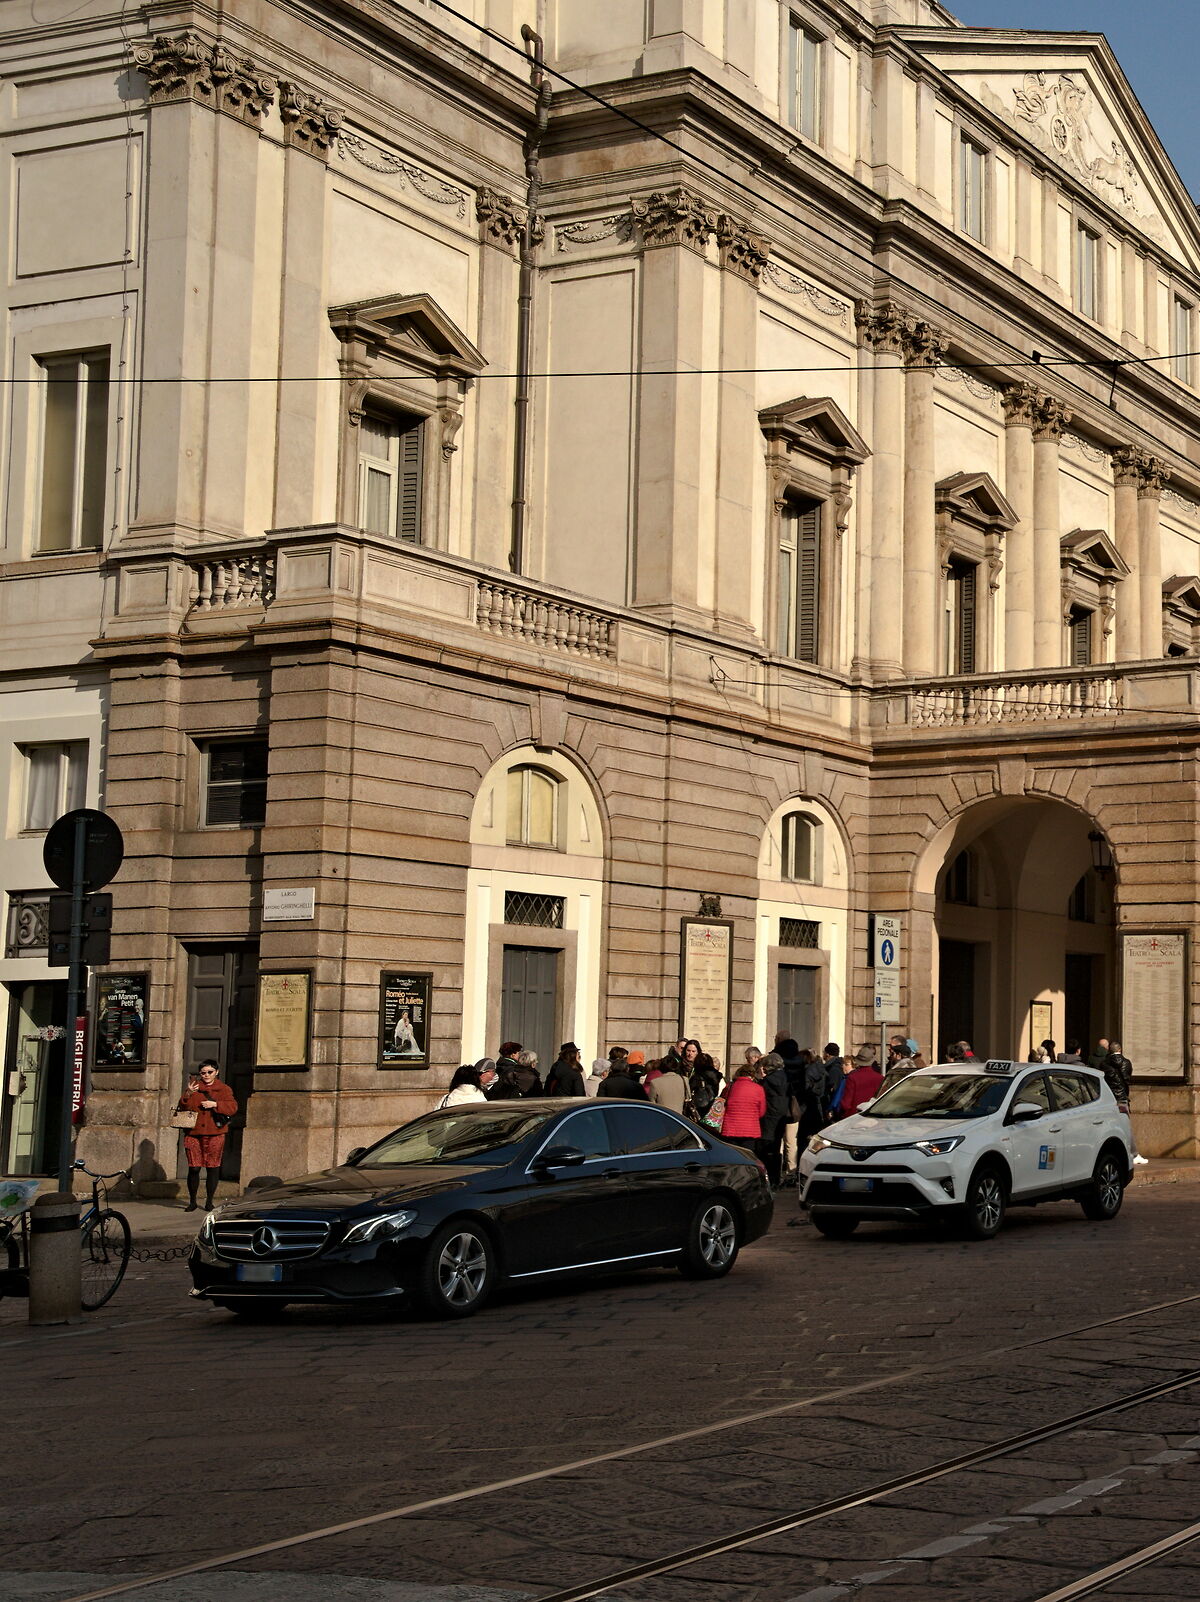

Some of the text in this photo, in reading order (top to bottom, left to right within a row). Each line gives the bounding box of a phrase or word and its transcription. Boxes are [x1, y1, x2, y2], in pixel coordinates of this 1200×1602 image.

[882, 919, 894, 928] AREA
[877, 927, 899, 938] PEDONALE
[1159, 949, 1182, 957] SCALA
